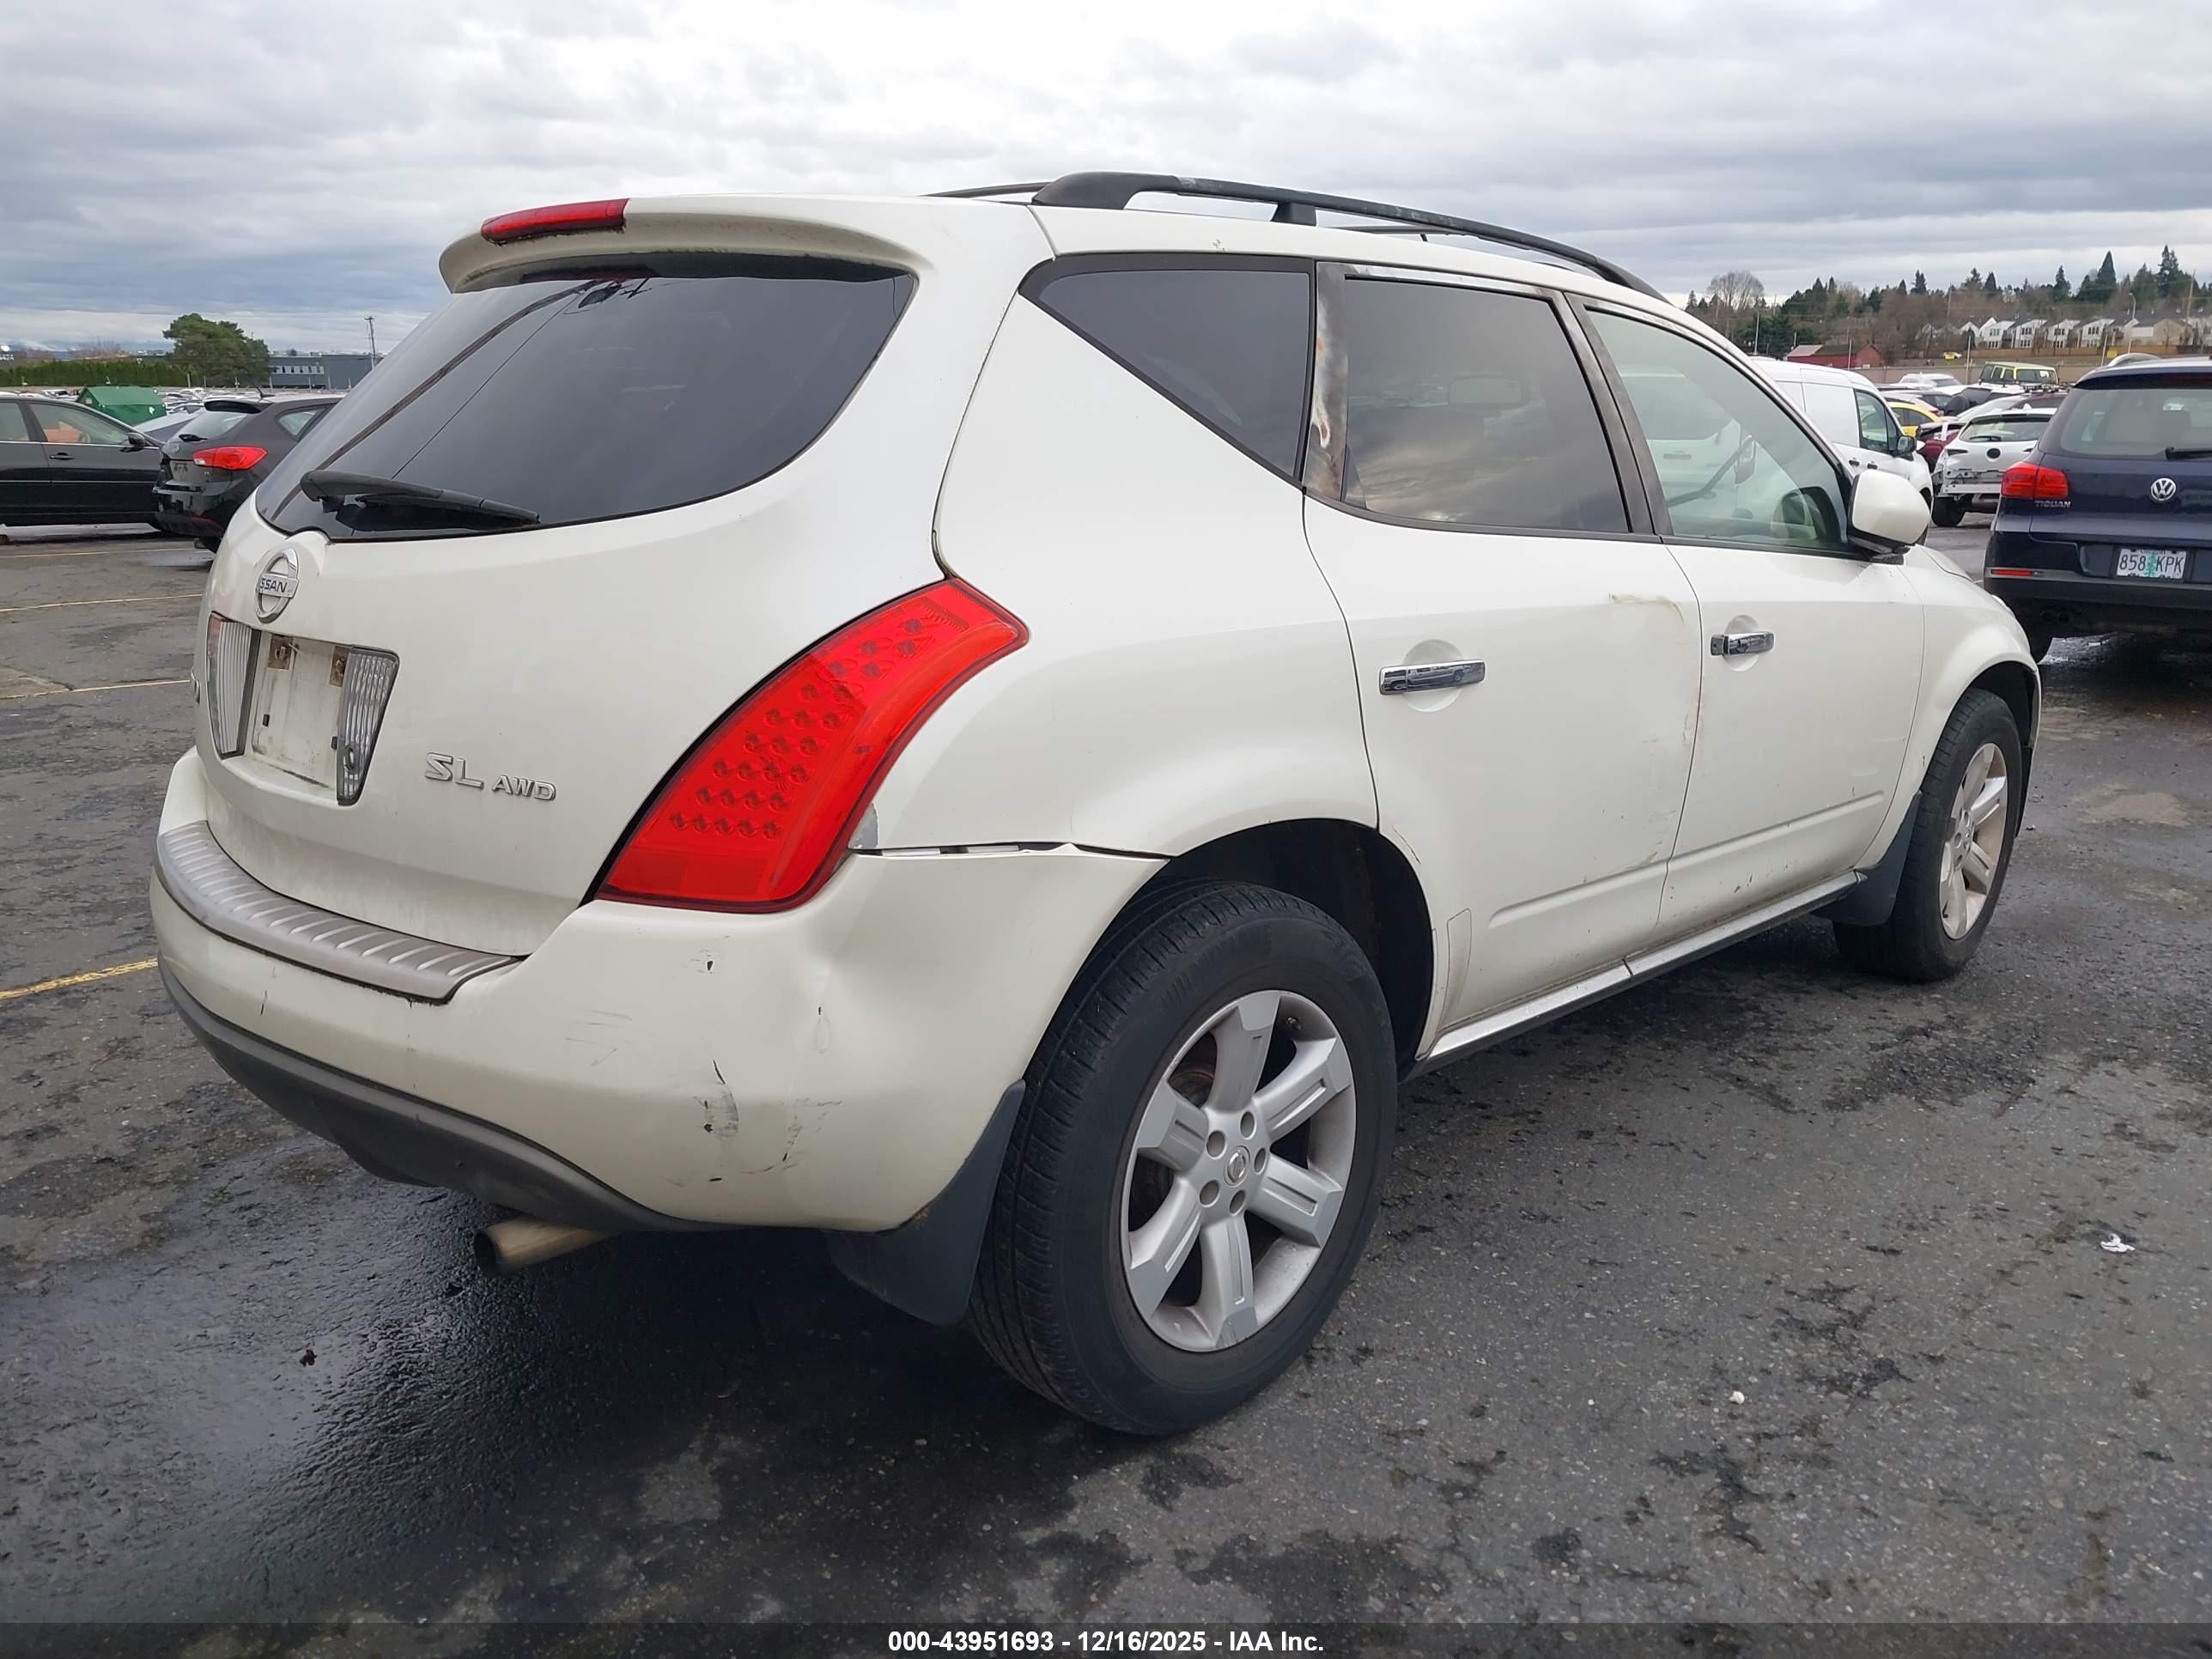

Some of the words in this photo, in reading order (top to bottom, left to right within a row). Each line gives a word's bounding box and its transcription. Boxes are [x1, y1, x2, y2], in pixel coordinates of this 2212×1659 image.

[2118, 554, 2147, 571] 858
[2155, 556, 2185, 573] KPK
[424, 751, 485, 791] SL
[491, 775, 557, 801] AWD
